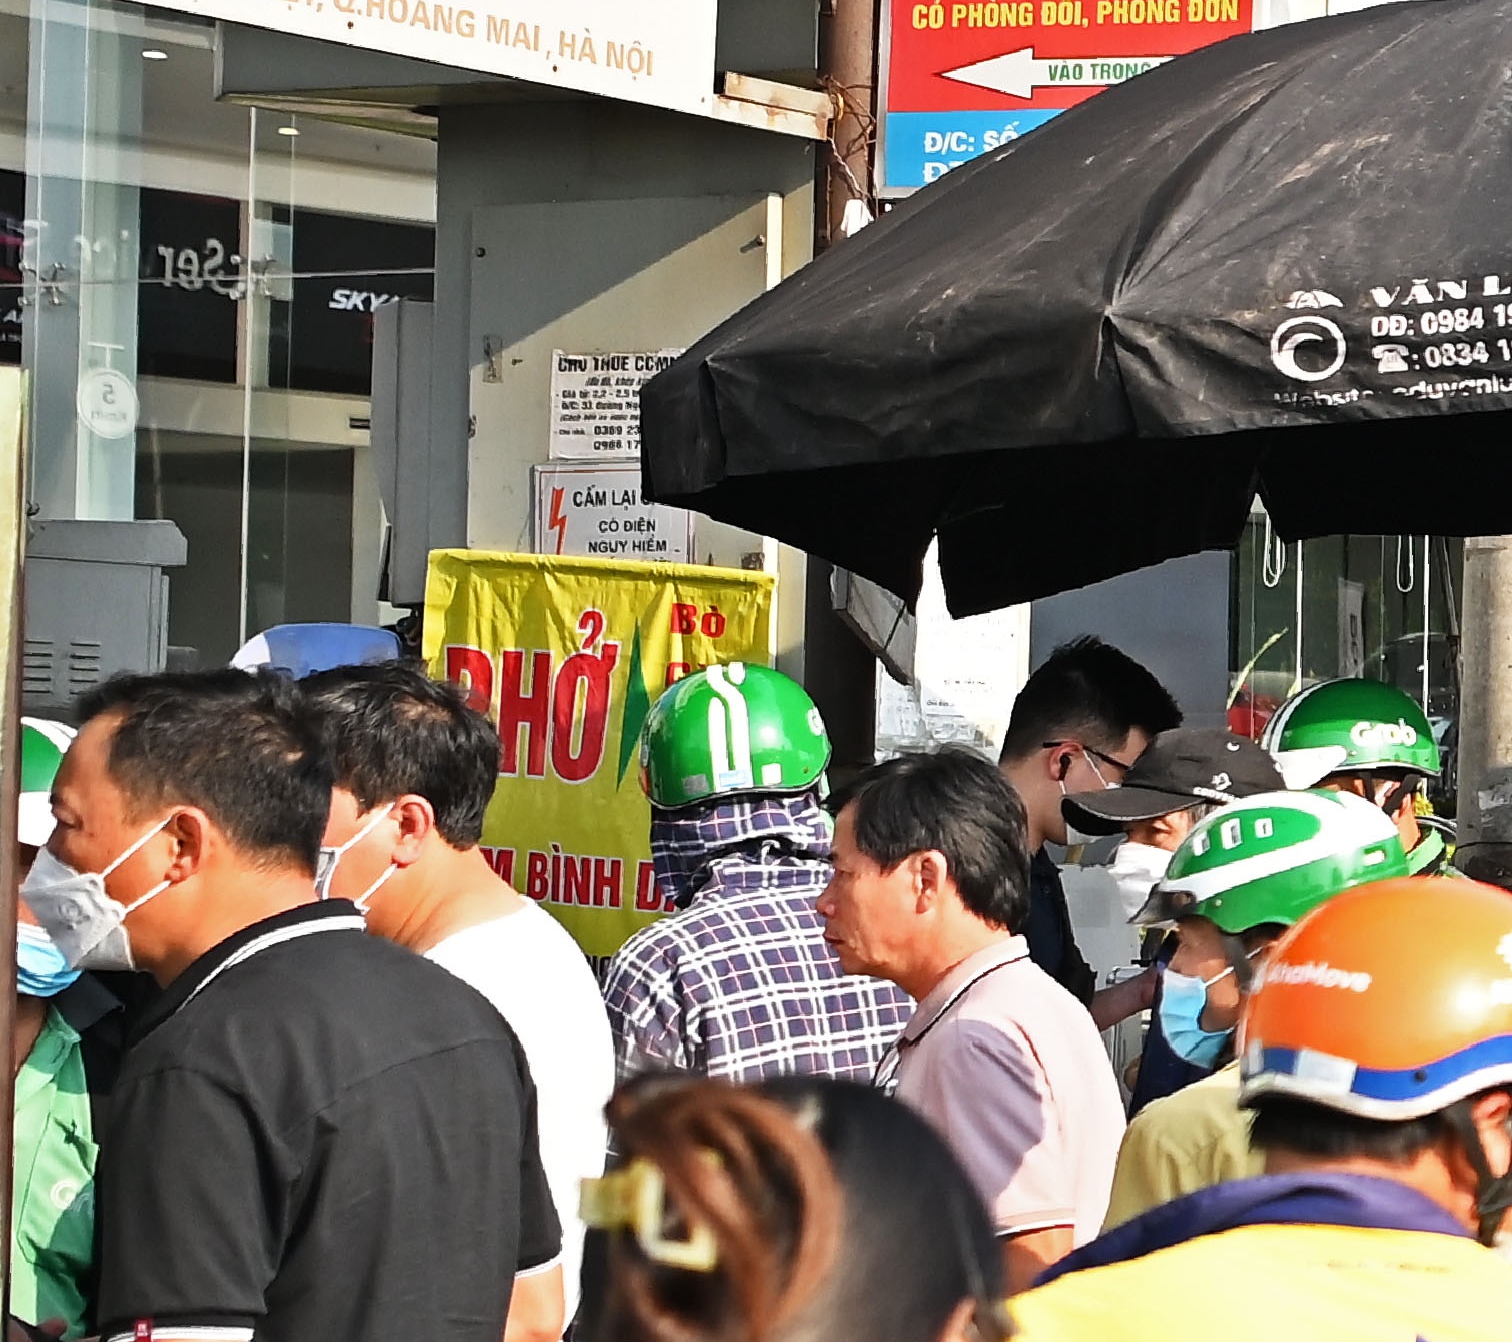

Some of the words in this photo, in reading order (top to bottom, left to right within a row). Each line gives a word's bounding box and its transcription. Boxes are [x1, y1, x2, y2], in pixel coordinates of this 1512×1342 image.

[912, 0, 944, 30] CÓ
[558, 27, 597, 70] HÀ
[606, 39, 655, 79] NỘI
[1048, 60, 1083, 82] VÀO
[924, 131, 975, 154] Đ/C:
[329, 288, 399, 313] SKY
[1420, 307, 1484, 335] 0984
[573, 484, 607, 508] CẤM
[612, 490, 636, 511] LẠI
[599, 517, 619, 533] CÓ
[624, 516, 656, 536] ĐIỆN
[588, 540, 628, 554] NGUY
[632, 534, 667, 553] HIỂM
[1350, 718, 1418, 747] Grab
[526, 843, 623, 909] BÌNH
